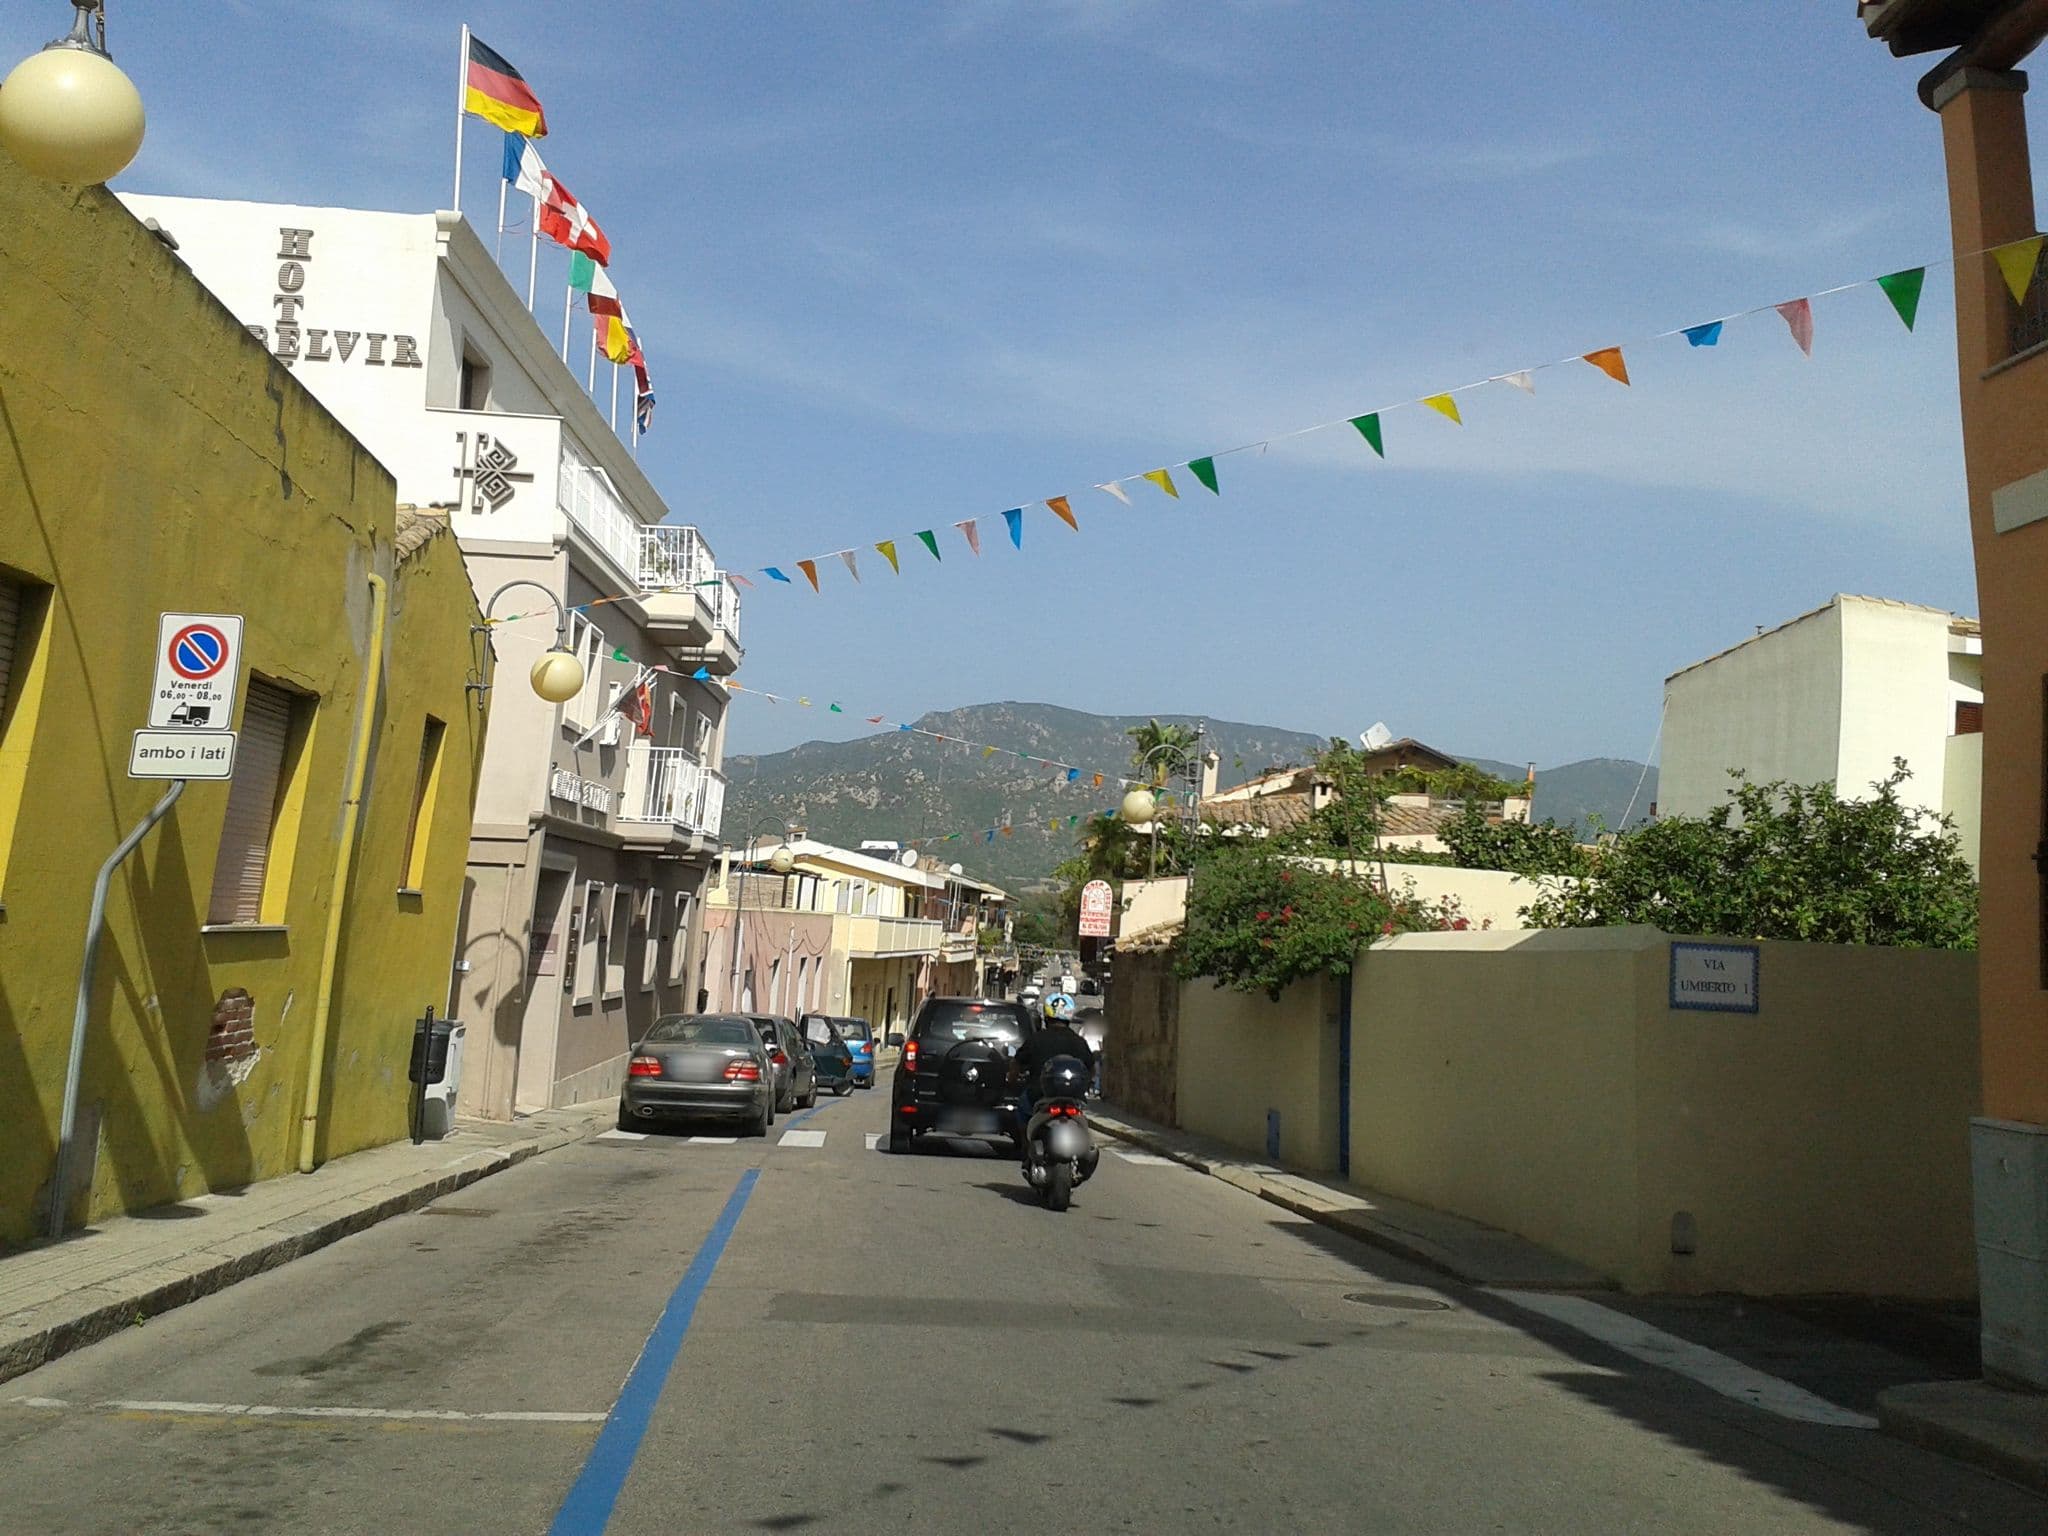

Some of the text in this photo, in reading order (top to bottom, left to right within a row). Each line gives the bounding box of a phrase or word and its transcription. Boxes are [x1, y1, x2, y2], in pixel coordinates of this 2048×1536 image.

[272, 227, 314, 368] HOTE
[139, 746, 226, 760] ambo i lati
[1704, 959, 1725, 971] VIA
[1681, 980, 1736, 993] UMBERTO
